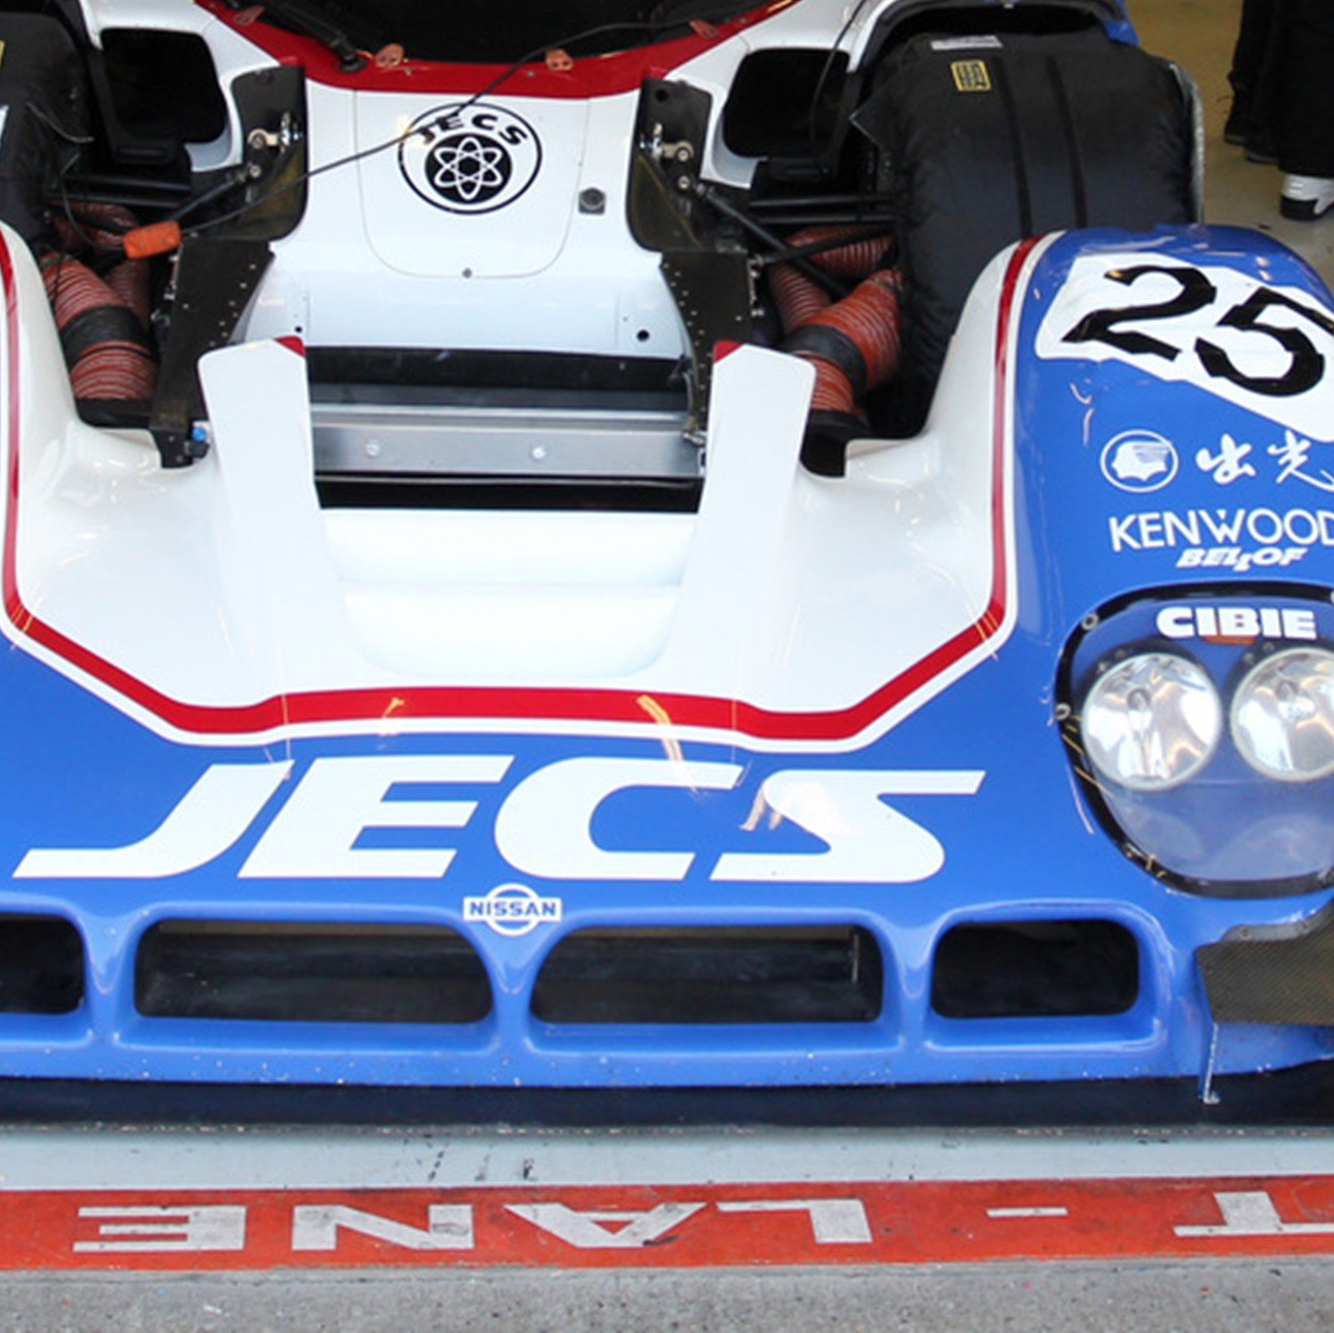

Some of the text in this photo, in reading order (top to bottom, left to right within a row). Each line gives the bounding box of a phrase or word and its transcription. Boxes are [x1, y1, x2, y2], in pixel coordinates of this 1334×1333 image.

[418, 112, 529, 147] JECS
[1155, 606, 1318, 641] CIBIE
[11, 754, 987, 883] JECS
[469, 900, 557, 917] NISSAN
[73, 1196, 874, 1253] LANE
